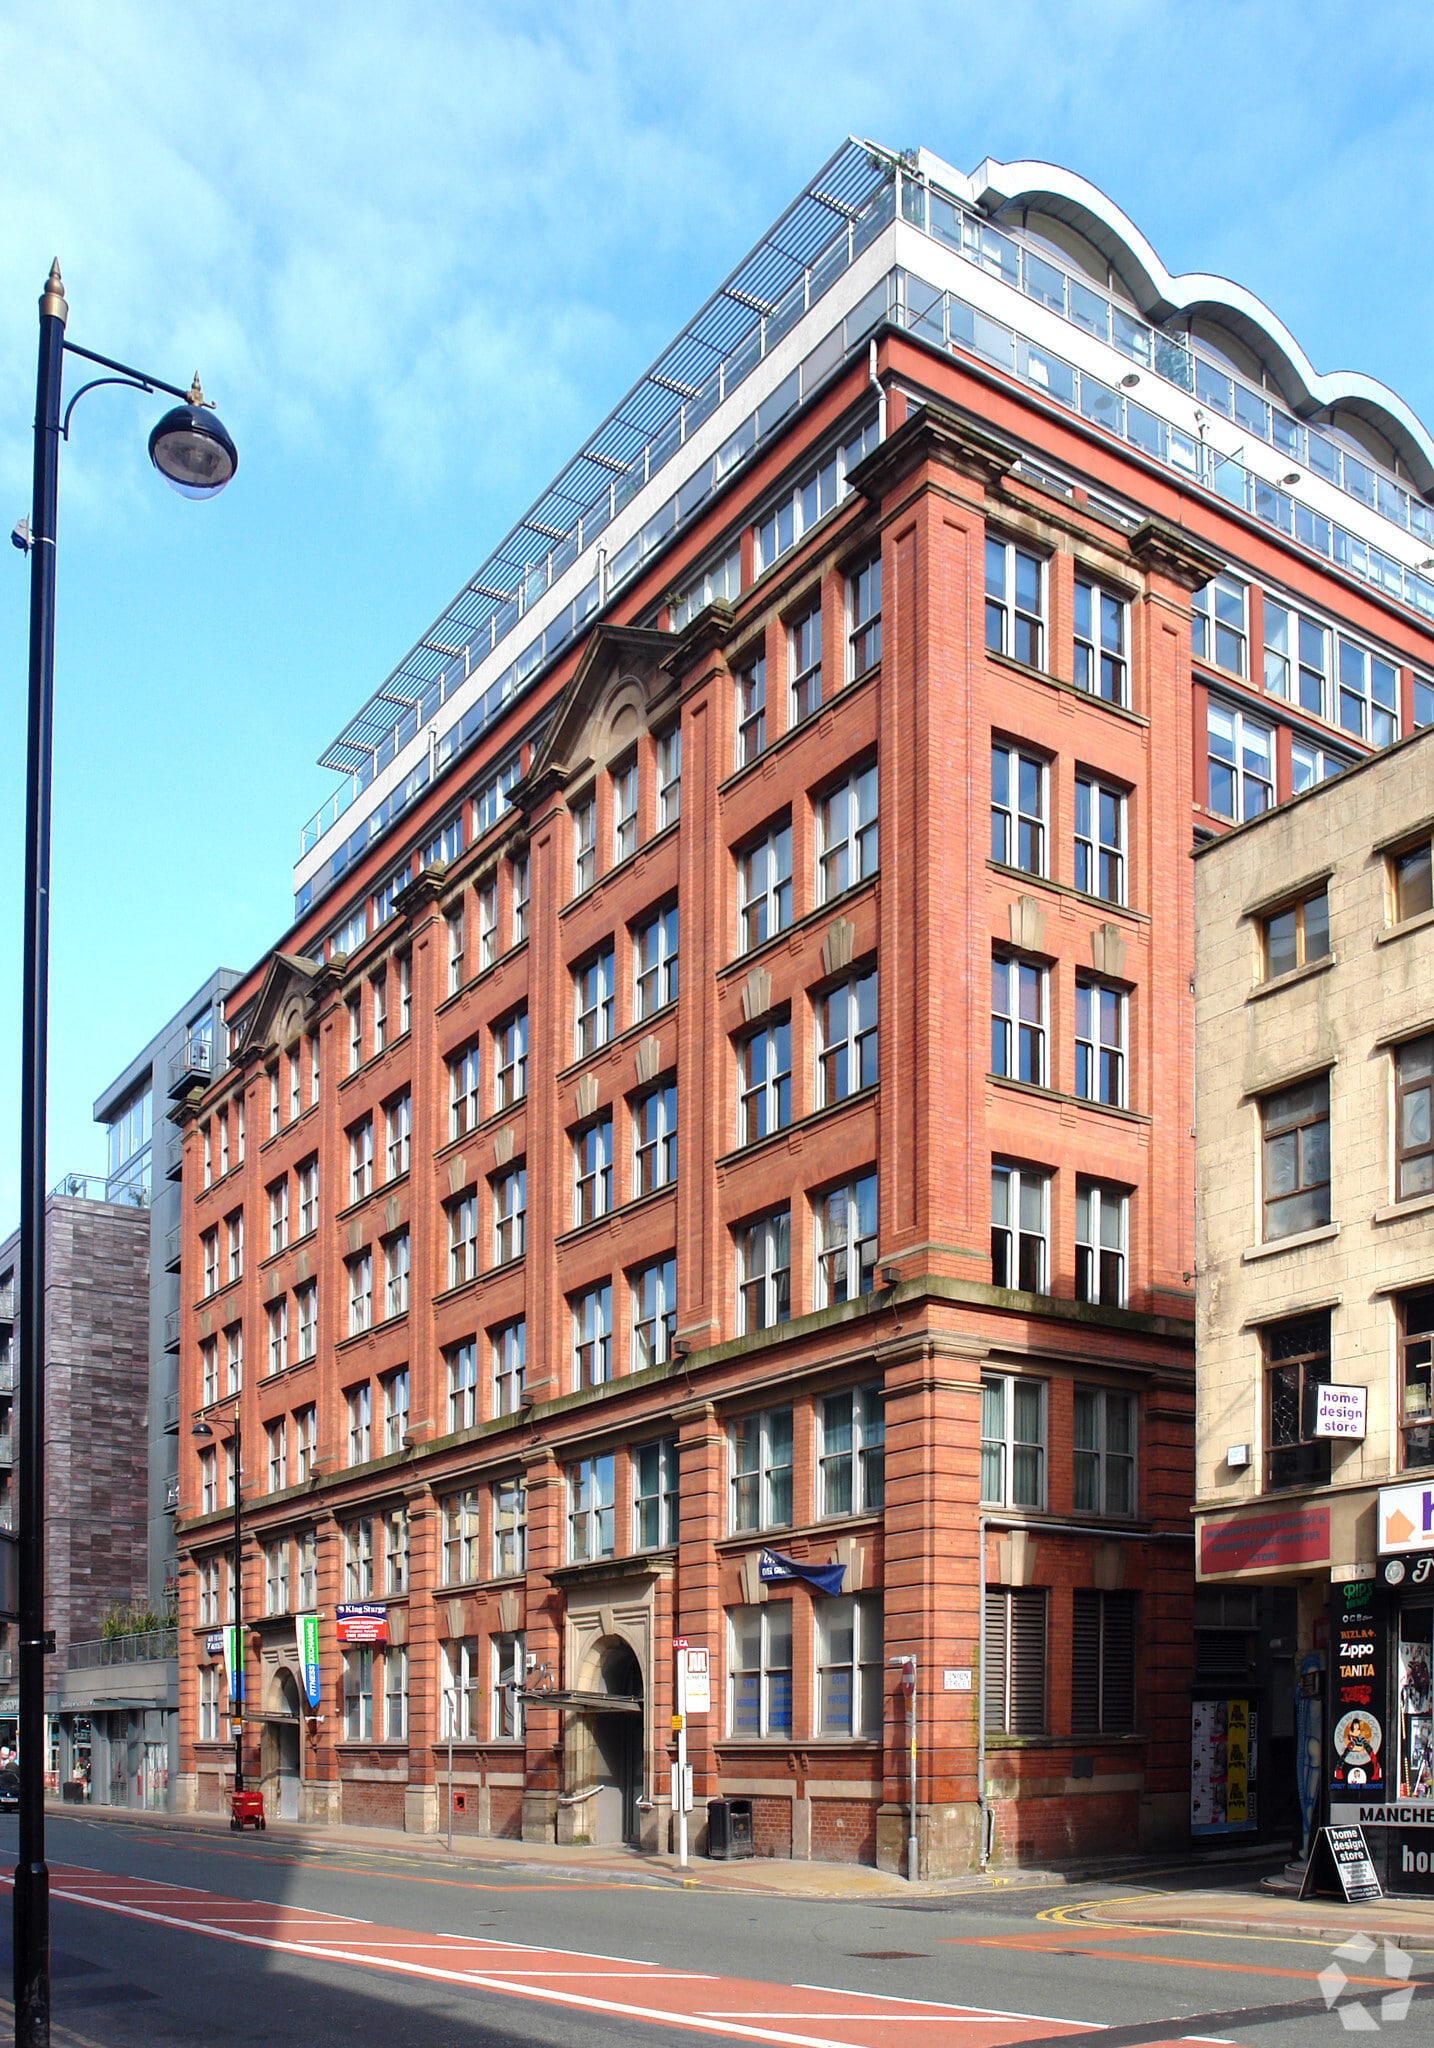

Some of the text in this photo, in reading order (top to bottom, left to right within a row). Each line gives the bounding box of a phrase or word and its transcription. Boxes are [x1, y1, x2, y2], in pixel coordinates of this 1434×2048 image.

[1323, 1391, 1358, 1403] home
[1320, 1405, 1362, 1420] design
[1325, 1421, 1357, 1432] store
[345, 1605, 363, 1614] King
[679, 1639, 688, 1647] CA
[1340, 1643, 1374, 1658] Zippo
[1340, 1664, 1375, 1677] TANITA
[1331, 1829, 1358, 1840] home
[1333, 1839, 1364, 1851] design
[1339, 1851, 1364, 1862] store
